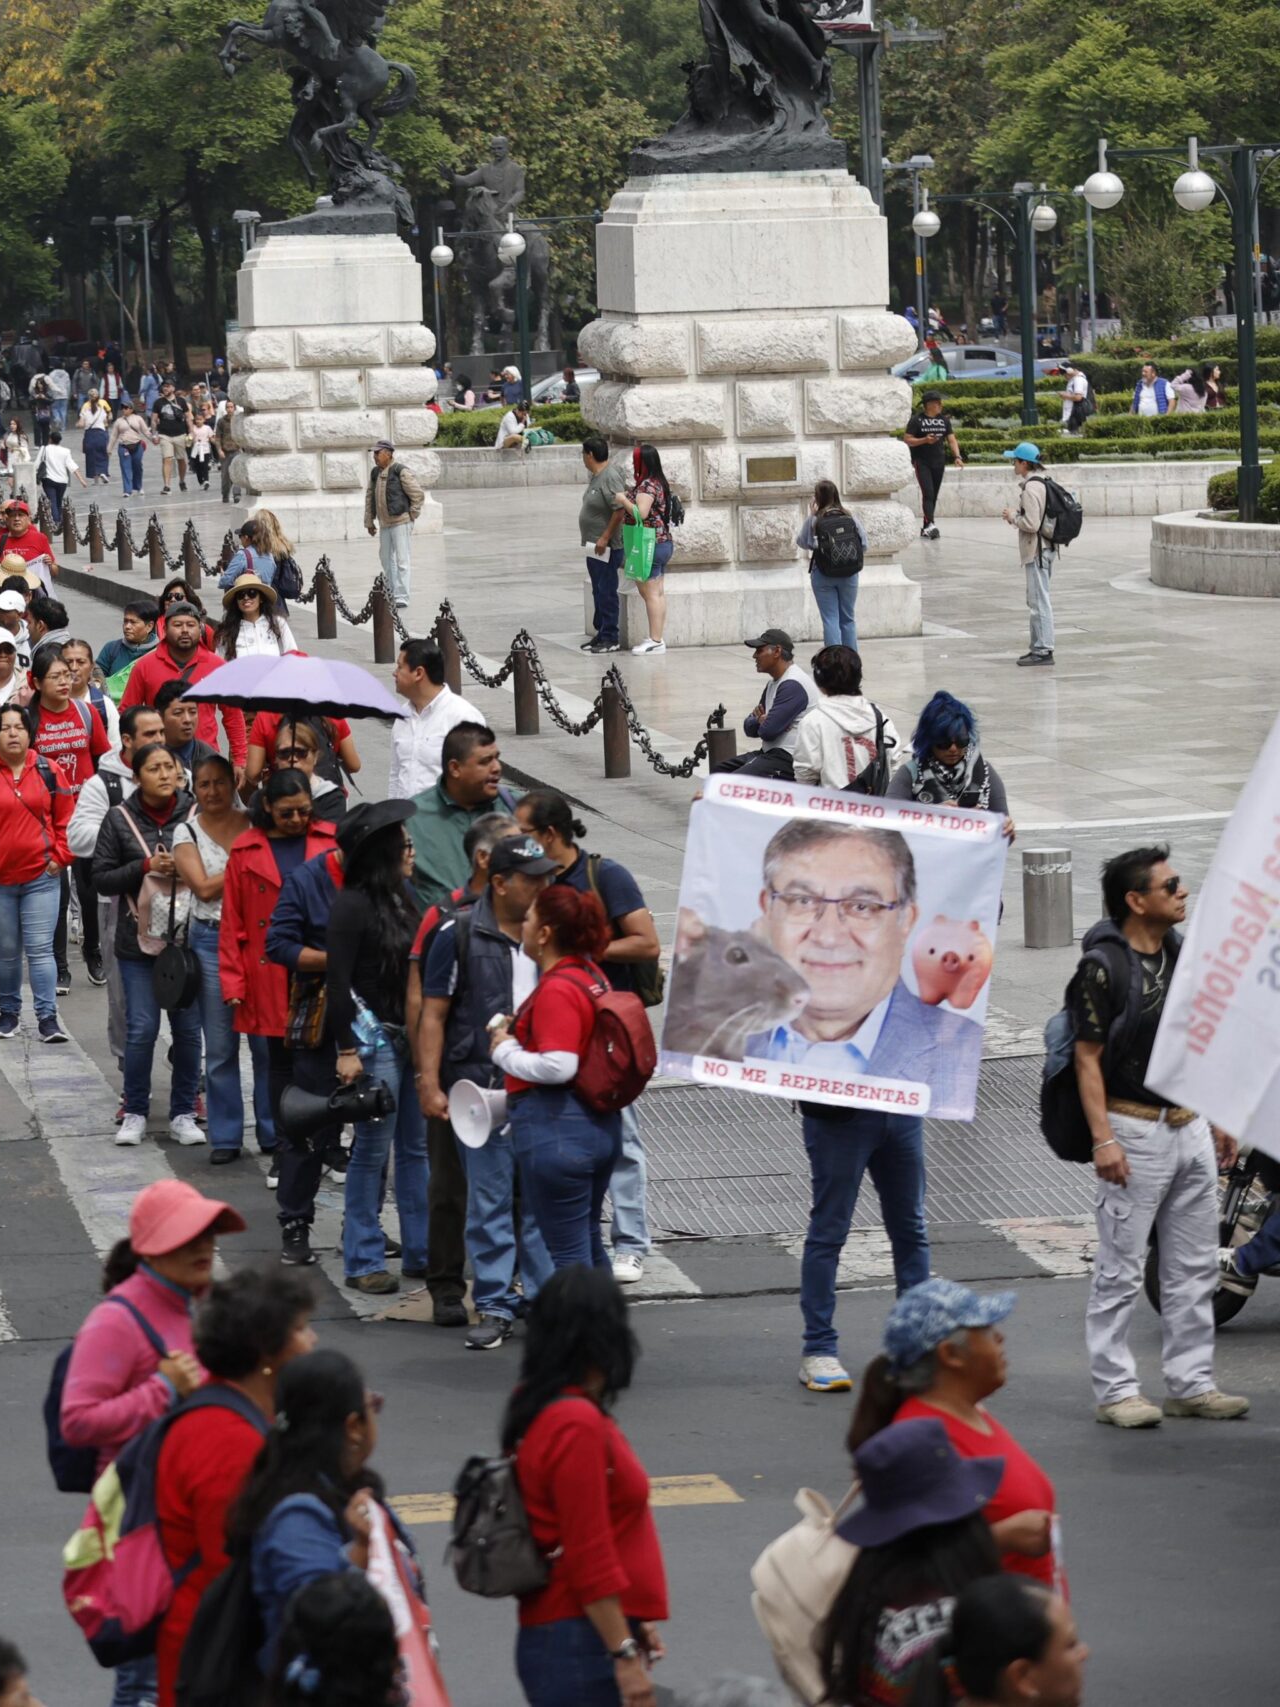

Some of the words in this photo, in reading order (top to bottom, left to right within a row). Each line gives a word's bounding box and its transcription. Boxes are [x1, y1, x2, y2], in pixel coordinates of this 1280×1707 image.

[720, 782, 795, 807] CEPEDA
[808, 796, 885, 819] CHARRO
[703, 1060, 728, 1078] NO
[741, 1067, 767, 1084] ME
[779, 1072, 920, 1107] REPRESENTAS
